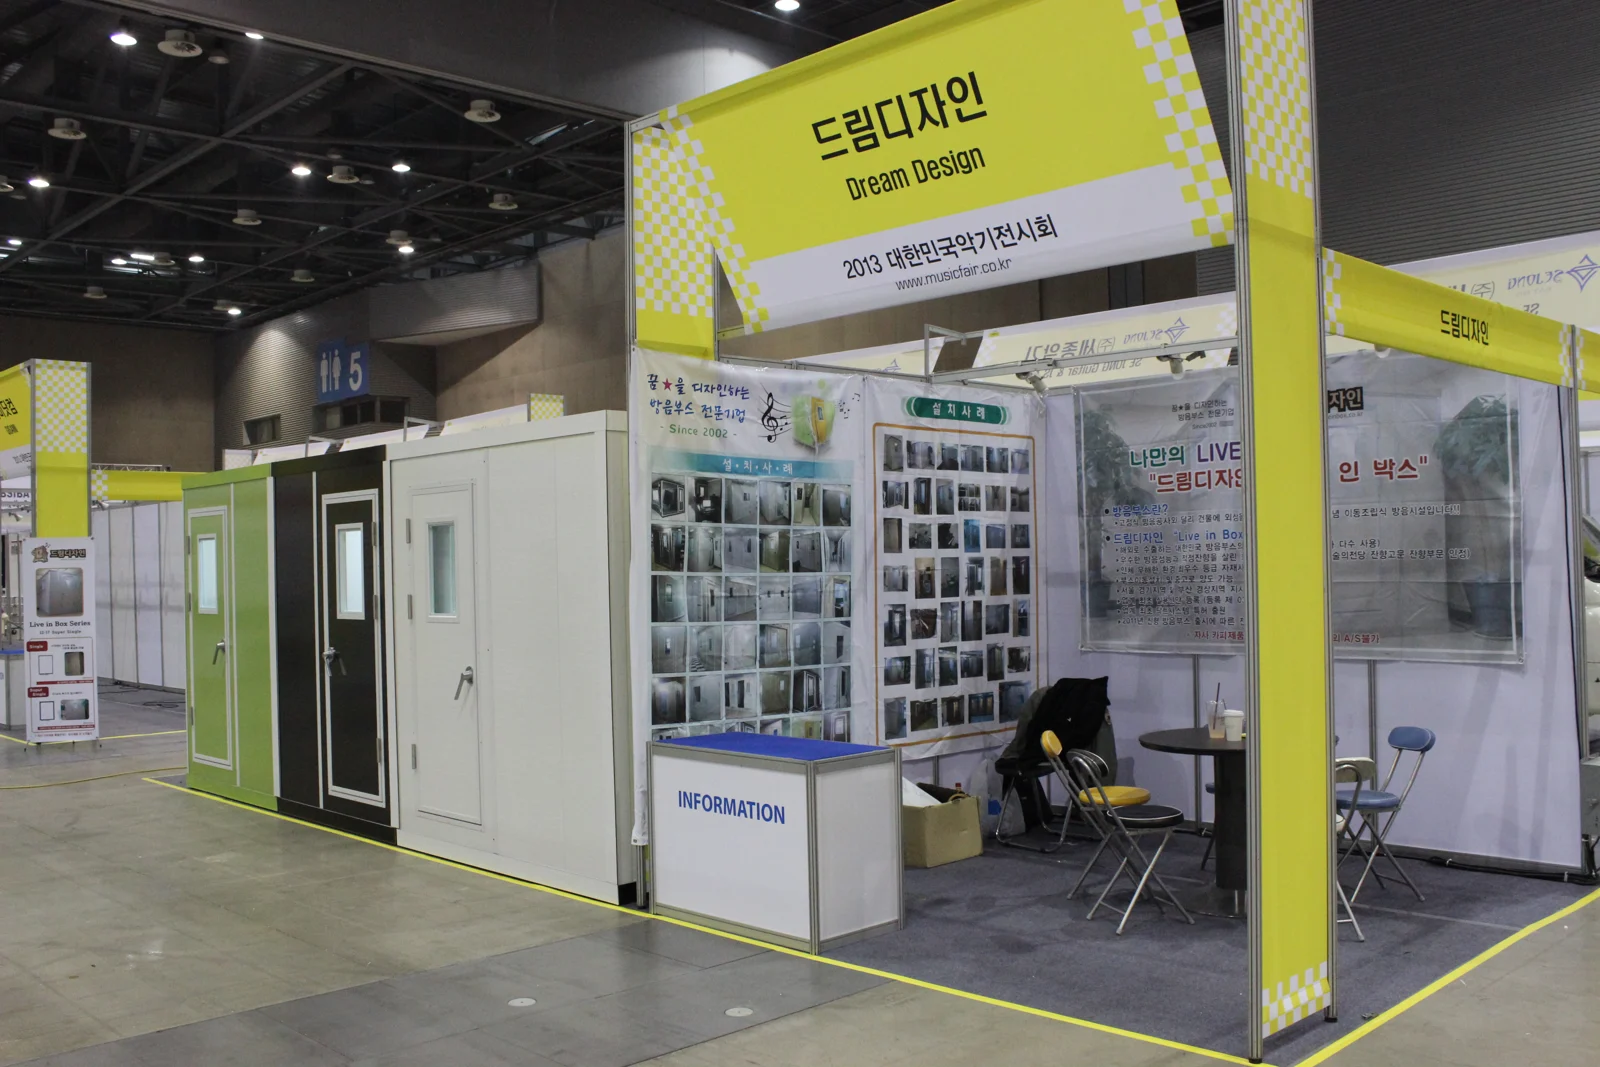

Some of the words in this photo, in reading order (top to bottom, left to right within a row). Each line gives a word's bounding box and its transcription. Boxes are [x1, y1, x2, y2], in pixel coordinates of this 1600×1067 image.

[811, 71, 988, 161] 드림디자인
[845, 167, 911, 201] Dream
[911, 146, 986, 184] Design
[842, 254, 883, 279] 2013
[885, 213, 1058, 270] 대한민국악기전시회
[895, 257, 1013, 291] www.musicfair.co.kr
[1440, 309, 1489, 346] 드림디자인
[348, 350, 363, 391] 5
[691, 382, 750, 400] 디자인하는
[649, 398, 696, 416] 방음부스
[701, 404, 747, 424] 전문기업
[669, 423, 699, 436] Since
[703, 427, 728, 439] 2002
[1129, 445, 1186, 469] 나만의
[1197, 441, 1241, 463] LIVE
[1112, 503, 1169, 517] 방음부스란?
[1344, 507, 1387, 518] 이동조립식
[1113, 531, 1163, 545] 드림디자인
[1205, 530, 1217, 540] in
[69, 620, 91, 628] Series
[678, 790, 786, 825] INFORMATION
